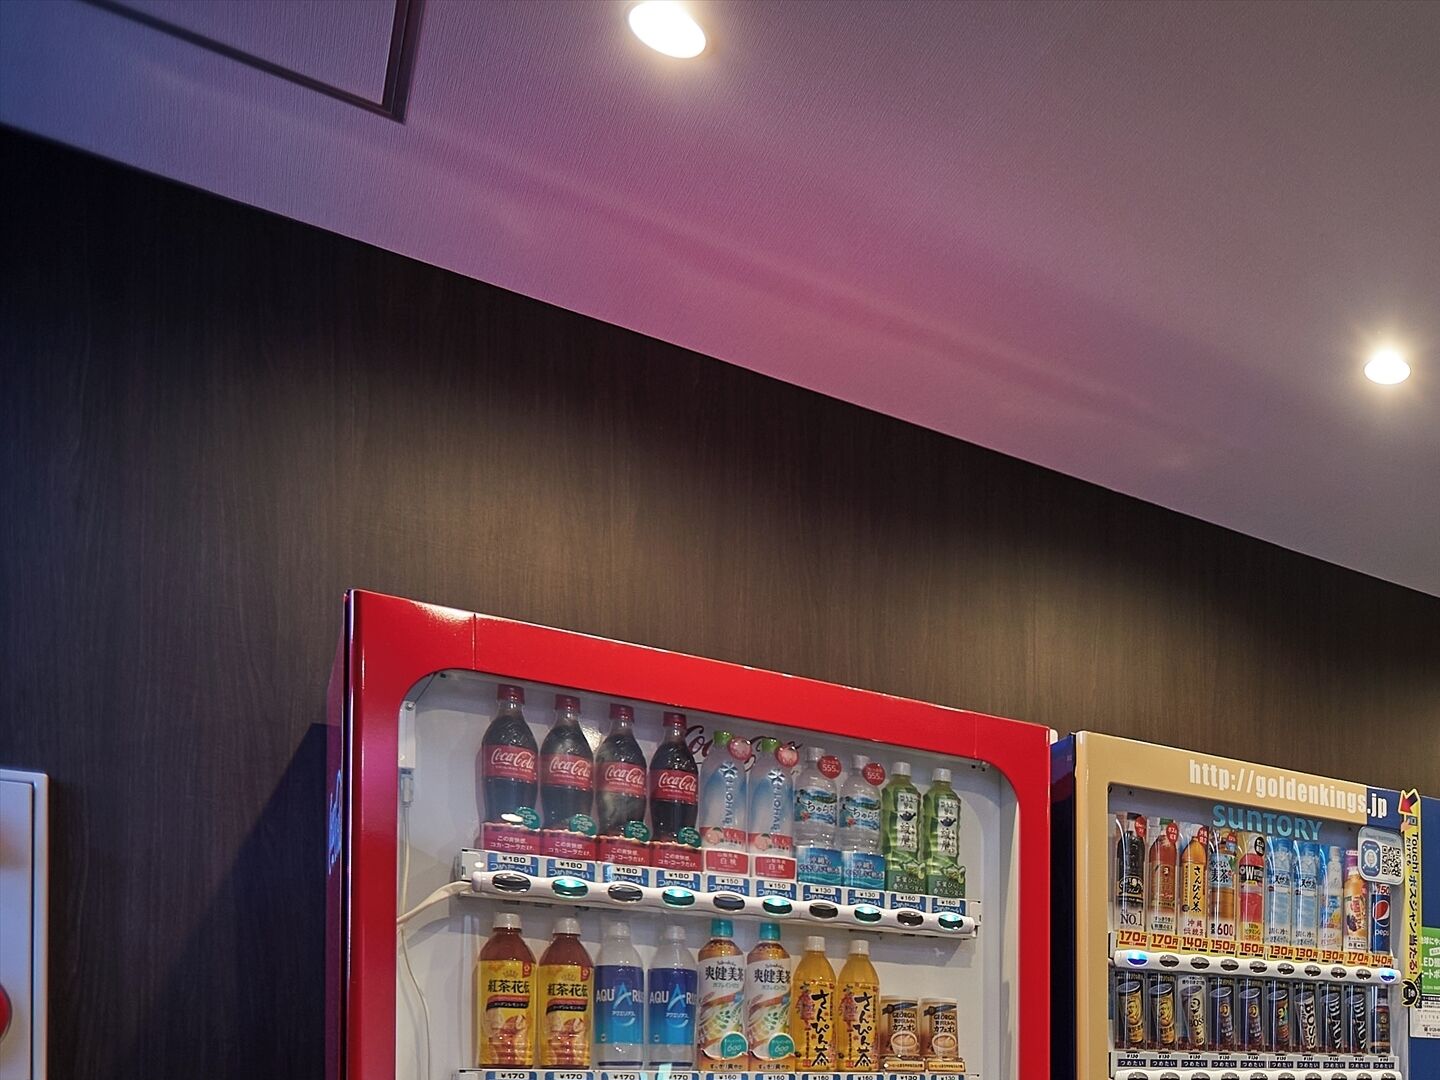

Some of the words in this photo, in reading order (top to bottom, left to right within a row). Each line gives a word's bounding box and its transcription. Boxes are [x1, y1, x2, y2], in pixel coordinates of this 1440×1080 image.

[1189, 760, 1387, 818] http://goldenkings.jp
[1120, 911, 1143, 926] NO.1
[1120, 931, 1147, 942] 170円
[1152, 934, 1179, 945] 170円
[1182, 937, 1209, 948] 140円
[1211, 940, 1236, 950] 150円
[1240, 943, 1264, 953] 160円
[1270, 945, 1294, 955] 130円
[1296, 948, 1318, 958] 130円
[1322, 950, 1344, 960] 130円
[1348, 952, 1369, 962] 170円
[1372, 955, 1392, 964] 140円
[501, 1072, 525, 1080] ¥170
[559, 1073, 583, 1080] ¥170
[613, 1073, 636, 1080] ¥170
